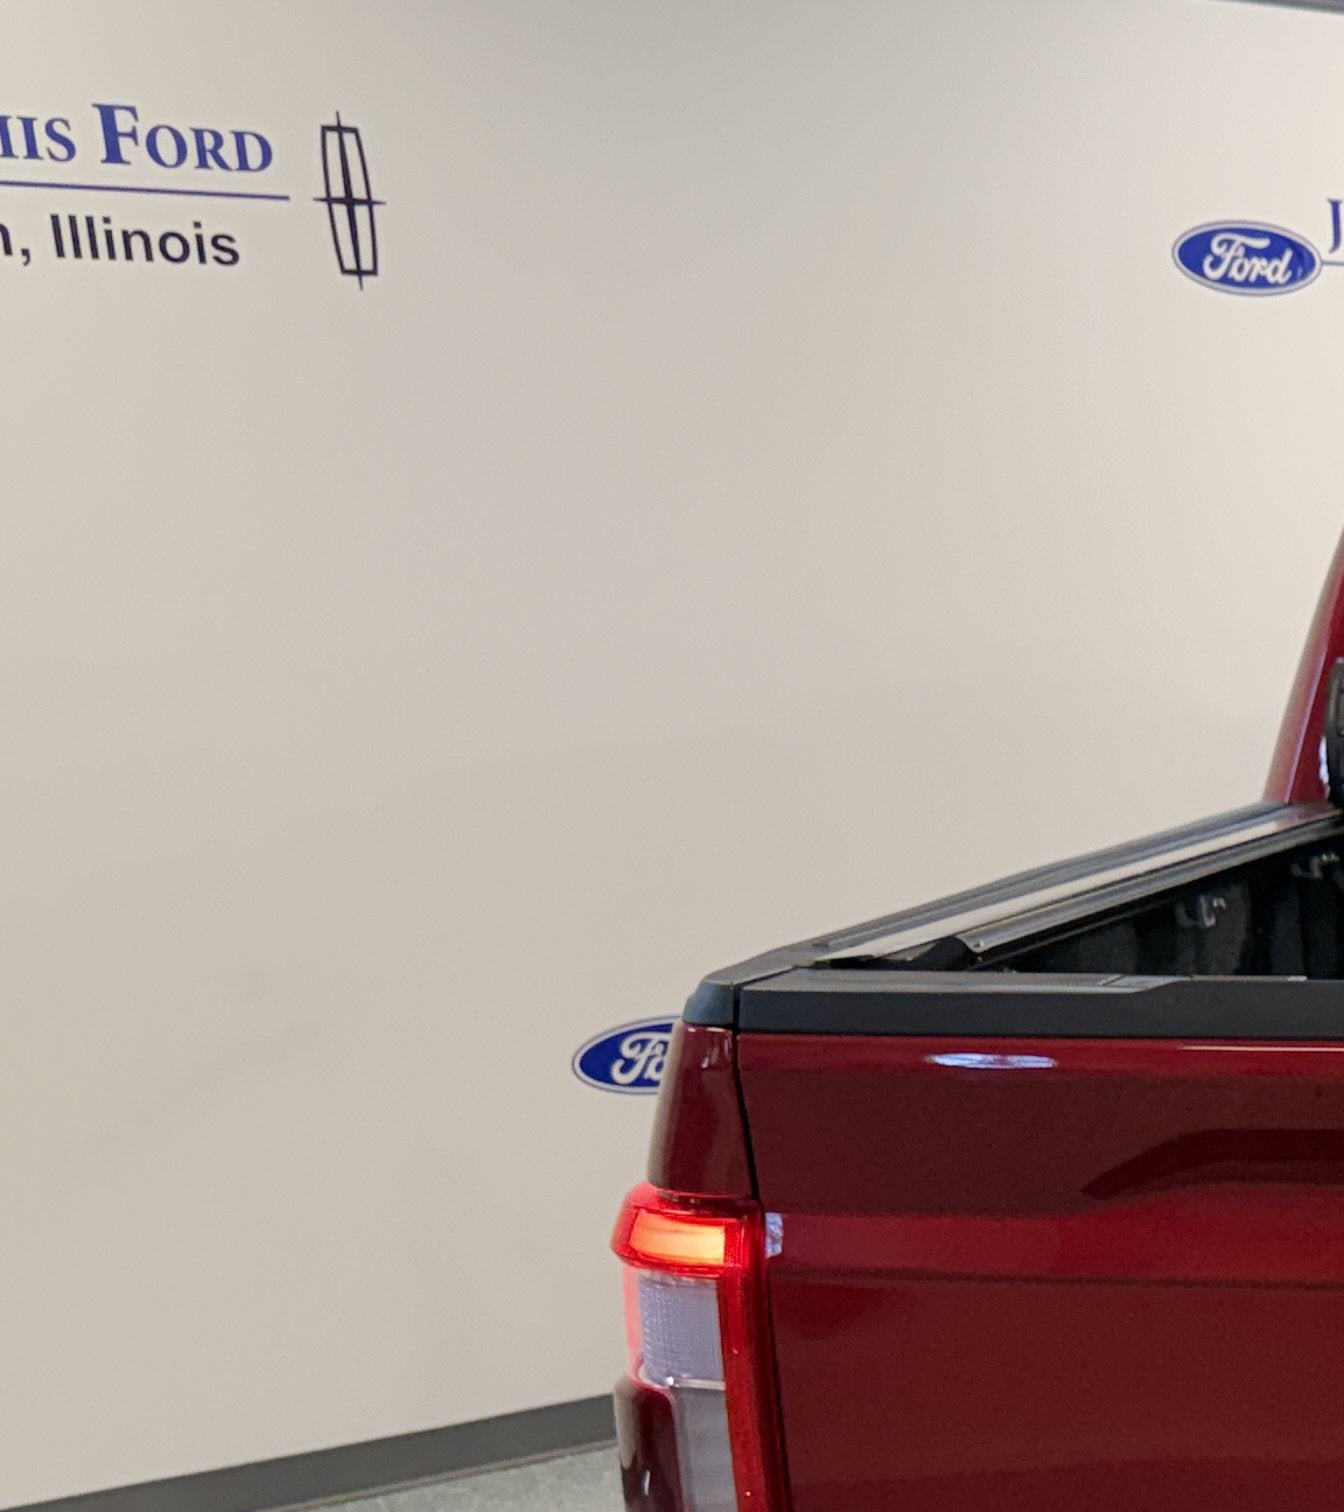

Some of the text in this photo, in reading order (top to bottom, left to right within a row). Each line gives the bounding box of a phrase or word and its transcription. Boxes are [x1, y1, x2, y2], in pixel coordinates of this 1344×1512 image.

[92, 103, 273, 172] FORD
[50, 213, 240, 266] Illinois
[1203, 232, 1295, 285] Ford
